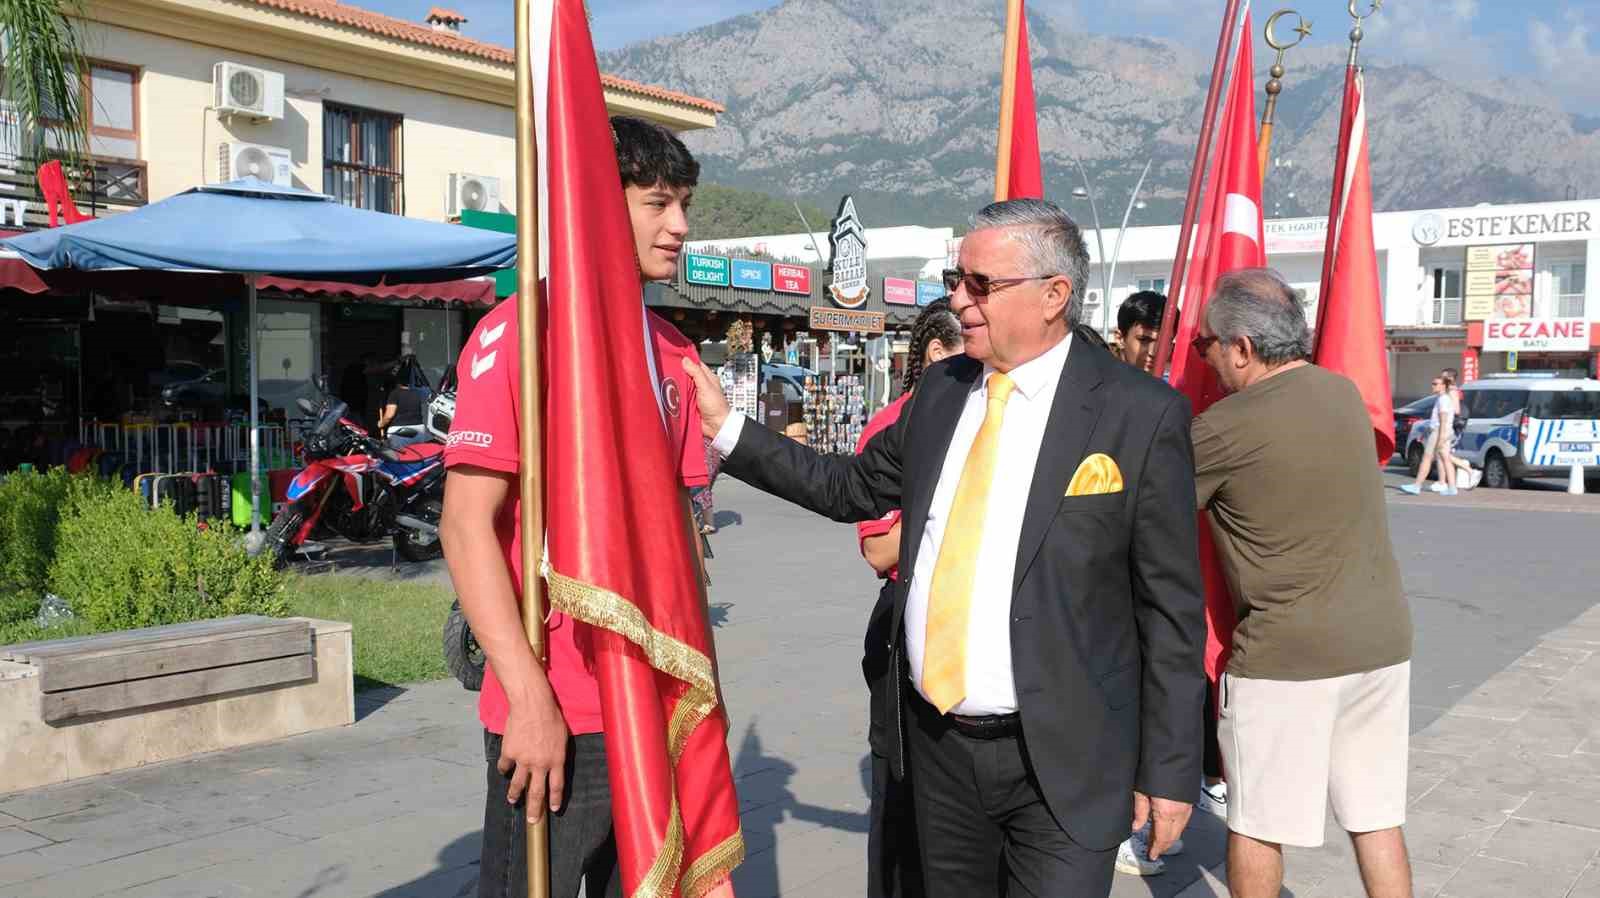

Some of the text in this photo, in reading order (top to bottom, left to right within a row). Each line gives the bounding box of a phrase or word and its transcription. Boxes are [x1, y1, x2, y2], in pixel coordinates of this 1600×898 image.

[1447, 211, 1592, 238] ESTE'KEMER
[692, 256, 724, 269] TURKISH
[834, 256, 860, 271] KULE
[692, 270, 724, 281] DELIGHT
[778, 267, 804, 279] HERBAL
[785, 280, 799, 290] TEA
[1488, 322, 1585, 338] ECZANE
